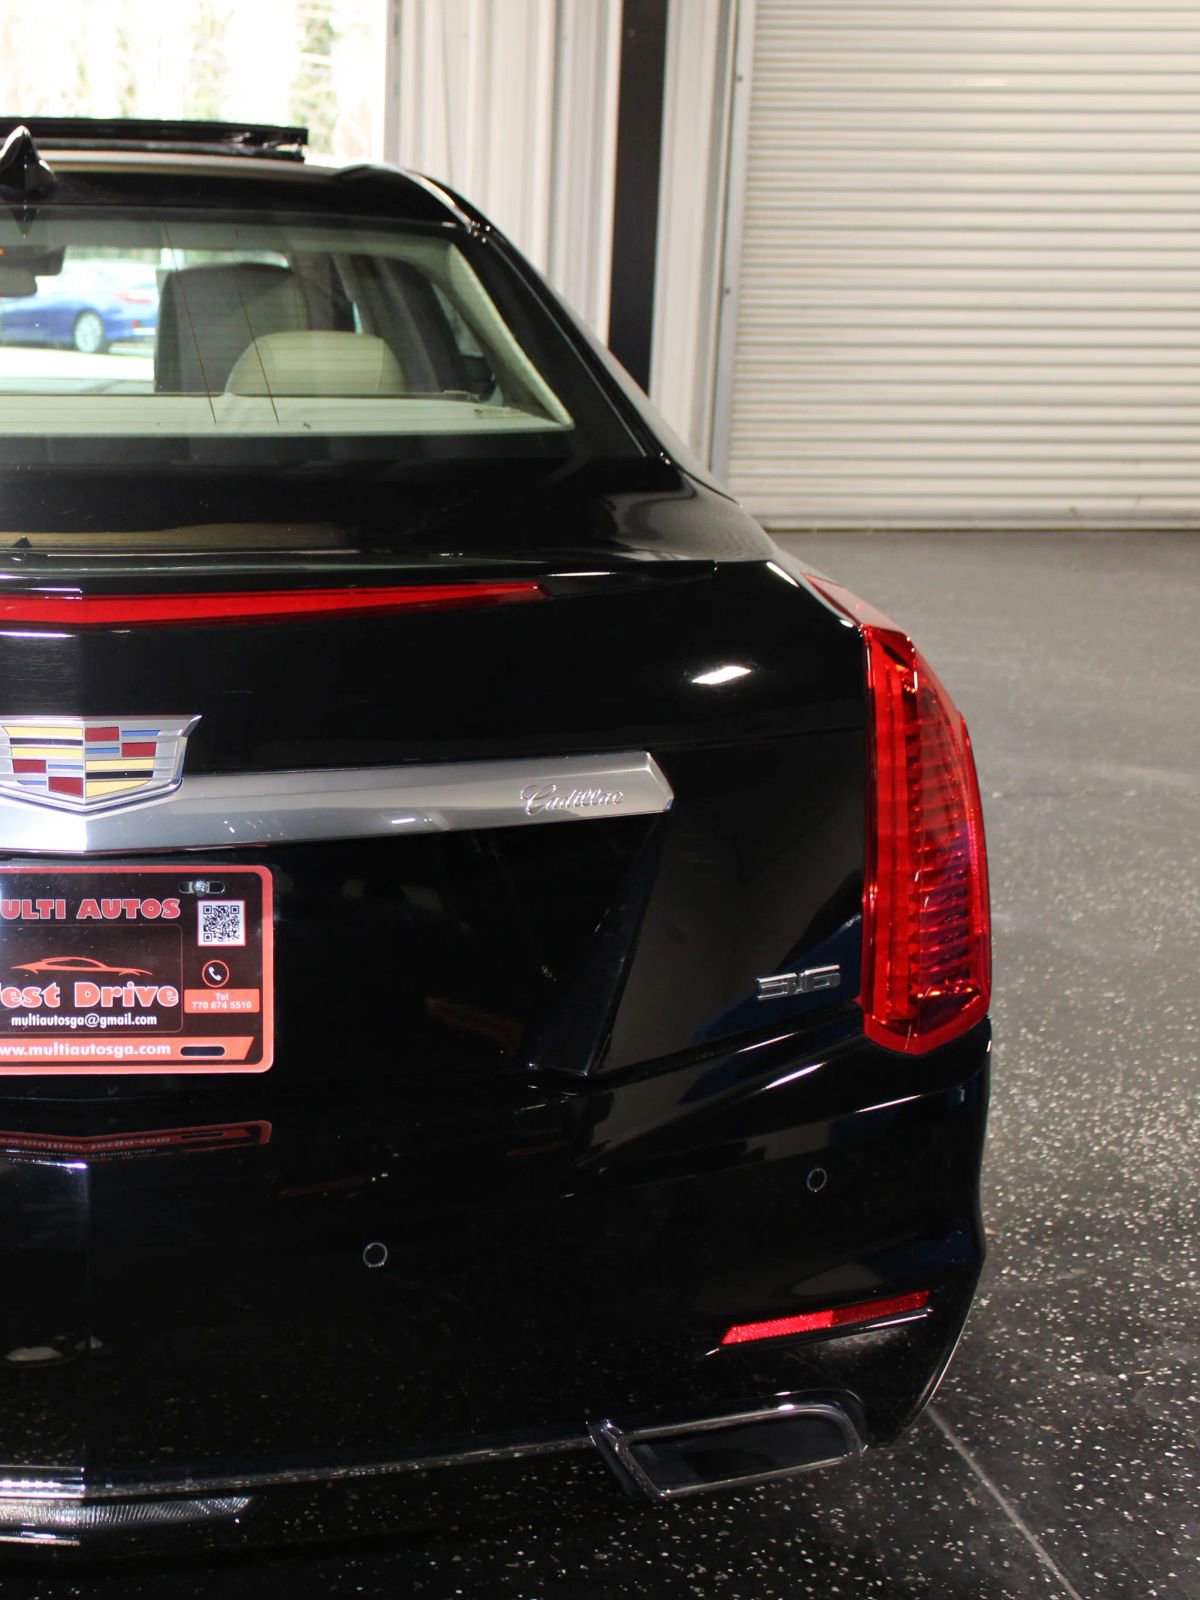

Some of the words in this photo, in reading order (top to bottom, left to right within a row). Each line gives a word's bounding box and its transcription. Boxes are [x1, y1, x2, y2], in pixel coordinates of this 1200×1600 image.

[519, 784, 623, 816] Cadillac
[76, 898, 181, 920] AUTOS
[74, 981, 179, 1008] Drive
[215, 992, 229, 1000] Tel
[192, 1001, 209, 1009] 770
[211, 1001, 227, 1009] 674
[230, 1001, 252, 1009] 5510
[11, 1012, 158, 1029] multiautosga@gmail.com
